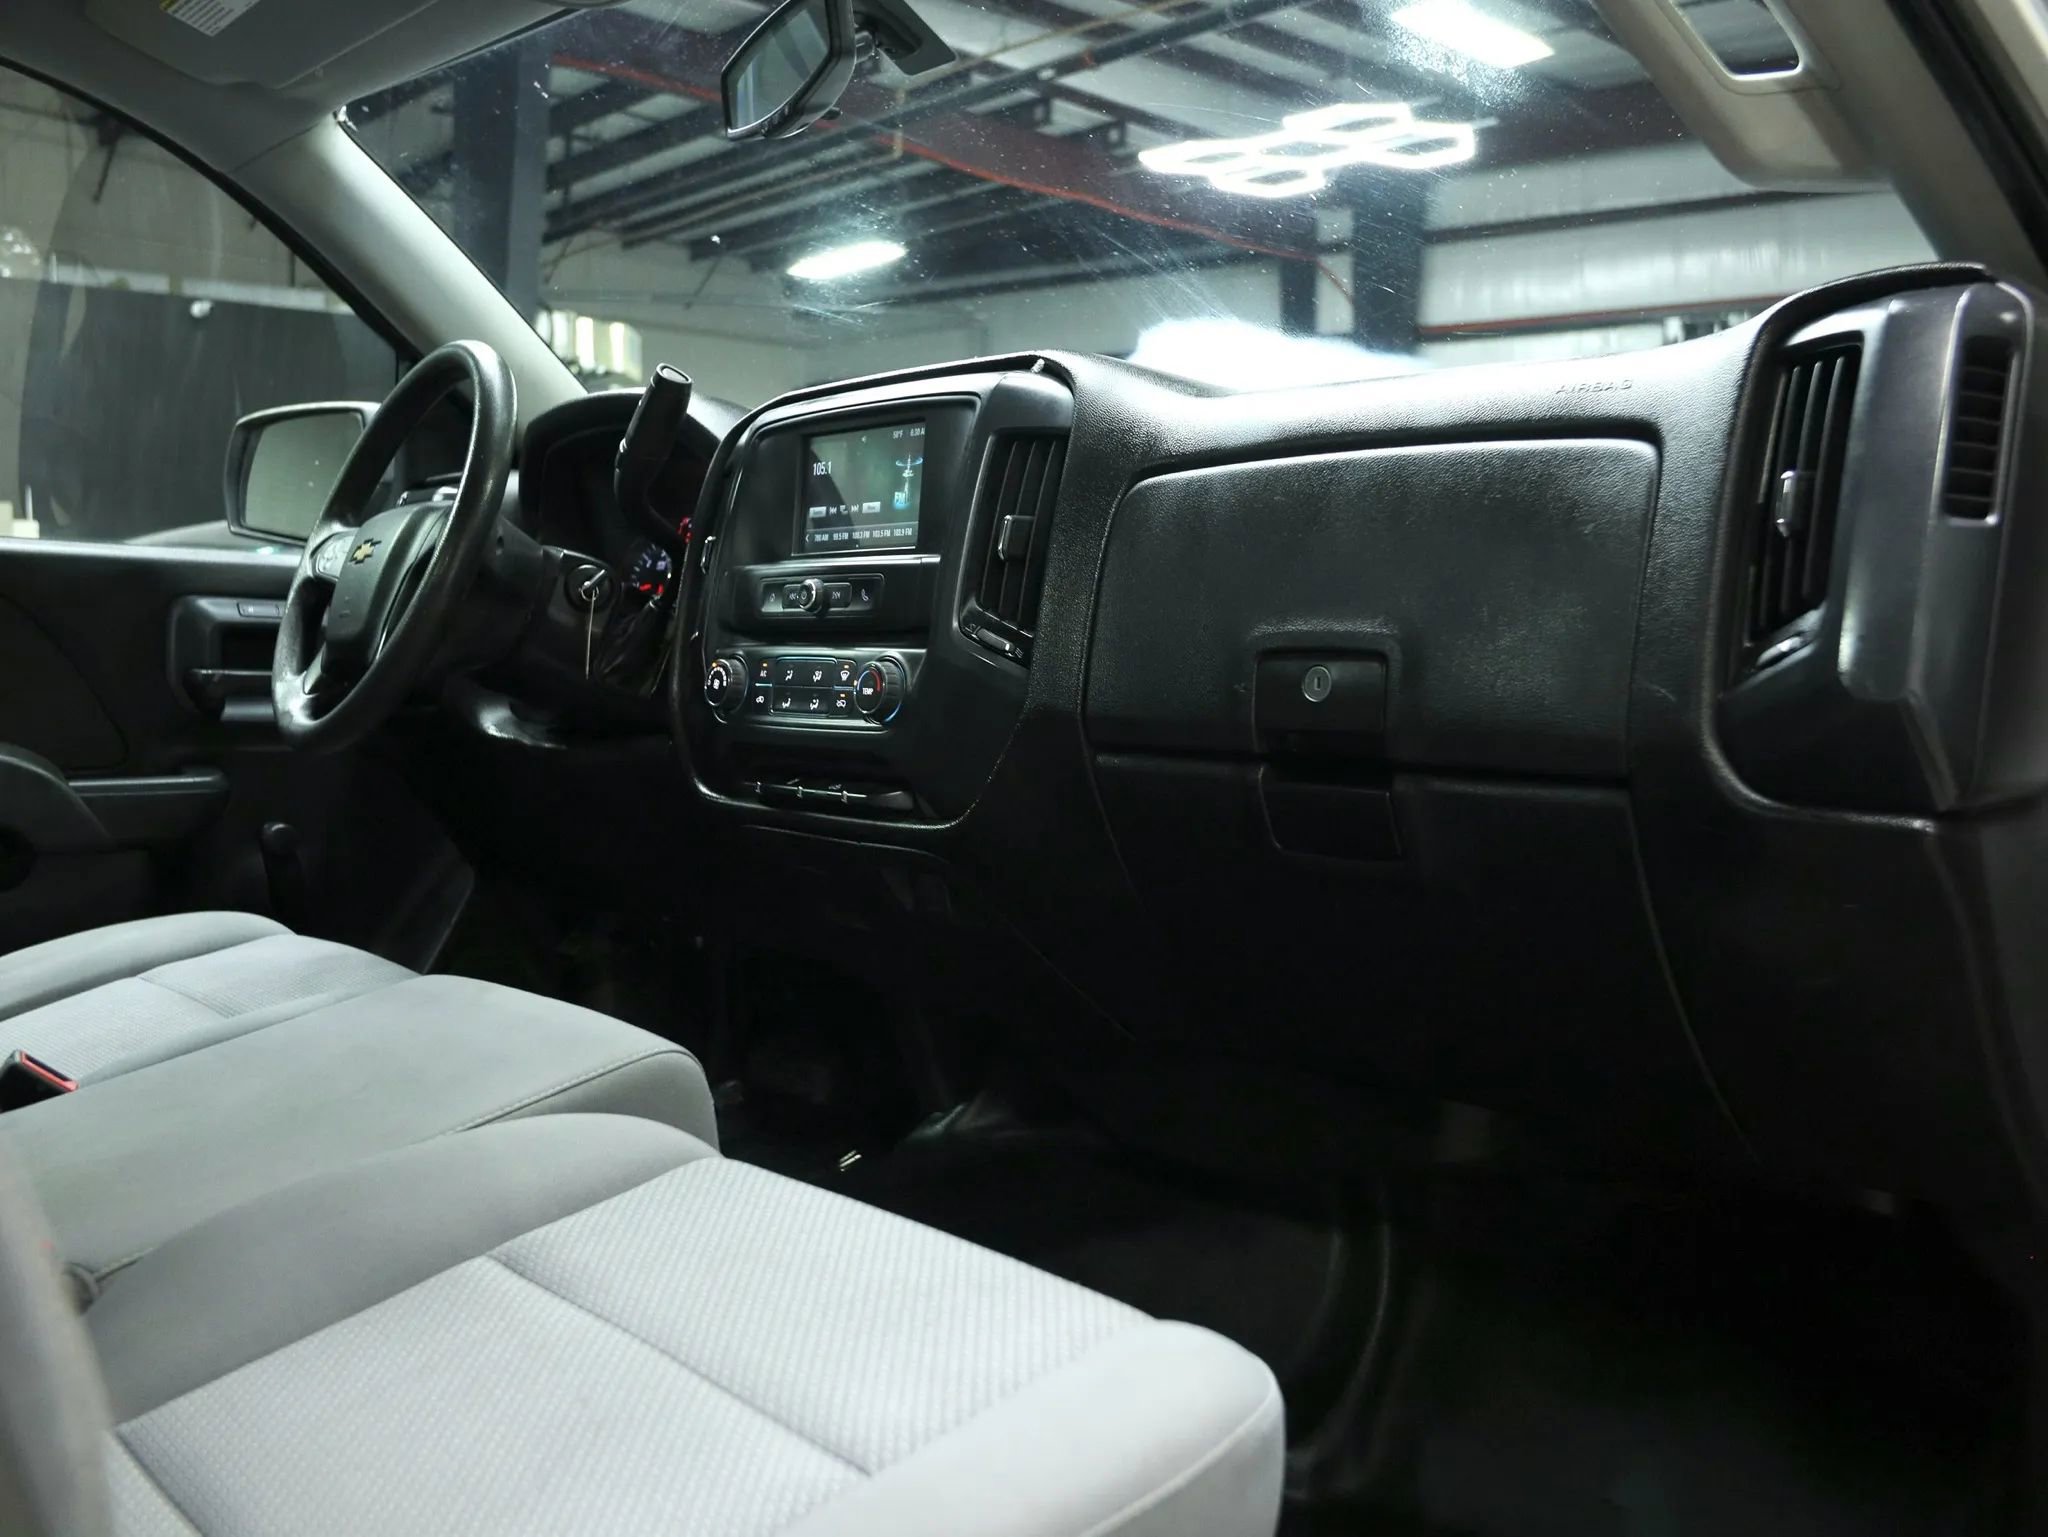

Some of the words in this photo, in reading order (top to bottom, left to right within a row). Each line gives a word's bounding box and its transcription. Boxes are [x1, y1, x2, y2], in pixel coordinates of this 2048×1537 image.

[1555, 379, 1633, 395] AIRBAG
[813, 461, 832, 476] 105.1
[862, 687, 874, 696] TEMP
